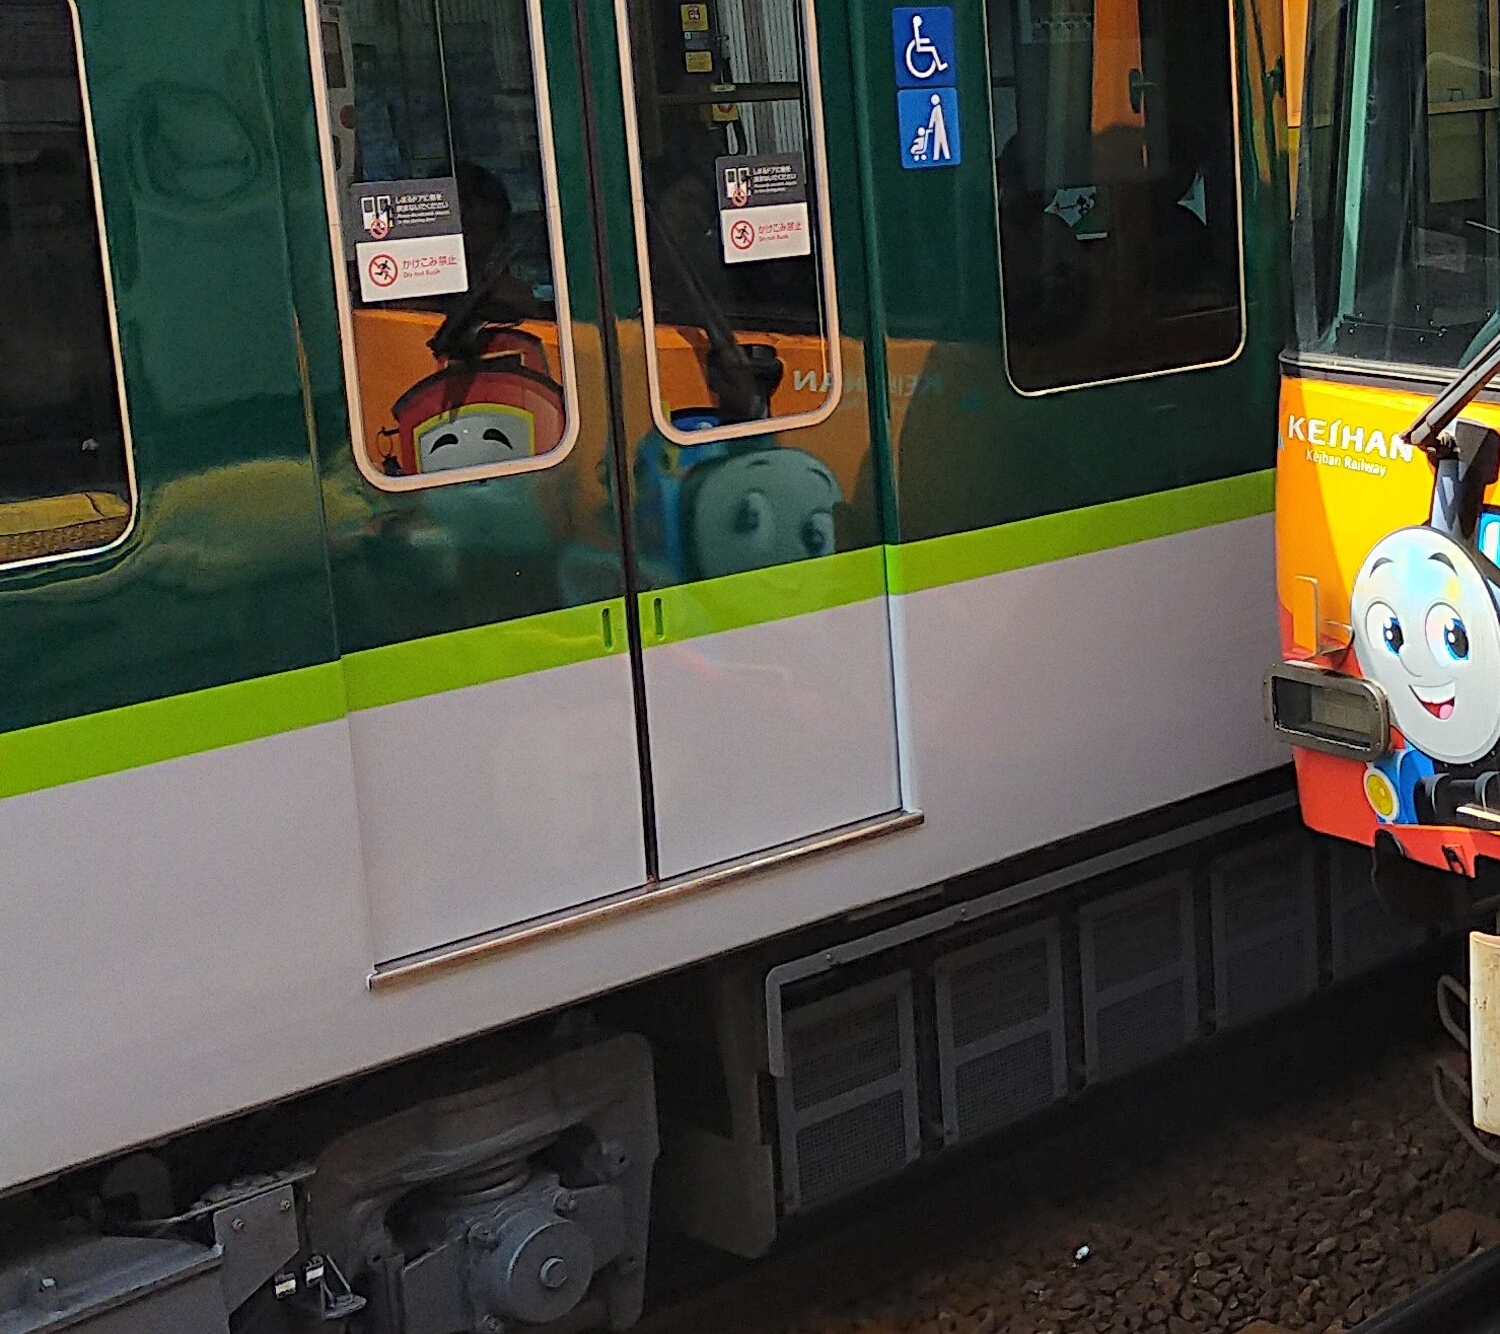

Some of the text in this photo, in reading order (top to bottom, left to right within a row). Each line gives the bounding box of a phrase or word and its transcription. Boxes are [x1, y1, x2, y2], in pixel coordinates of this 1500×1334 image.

[403, 255, 457, 269] かけこみ禁止
[1343, 455, 1387, 478] Railway
